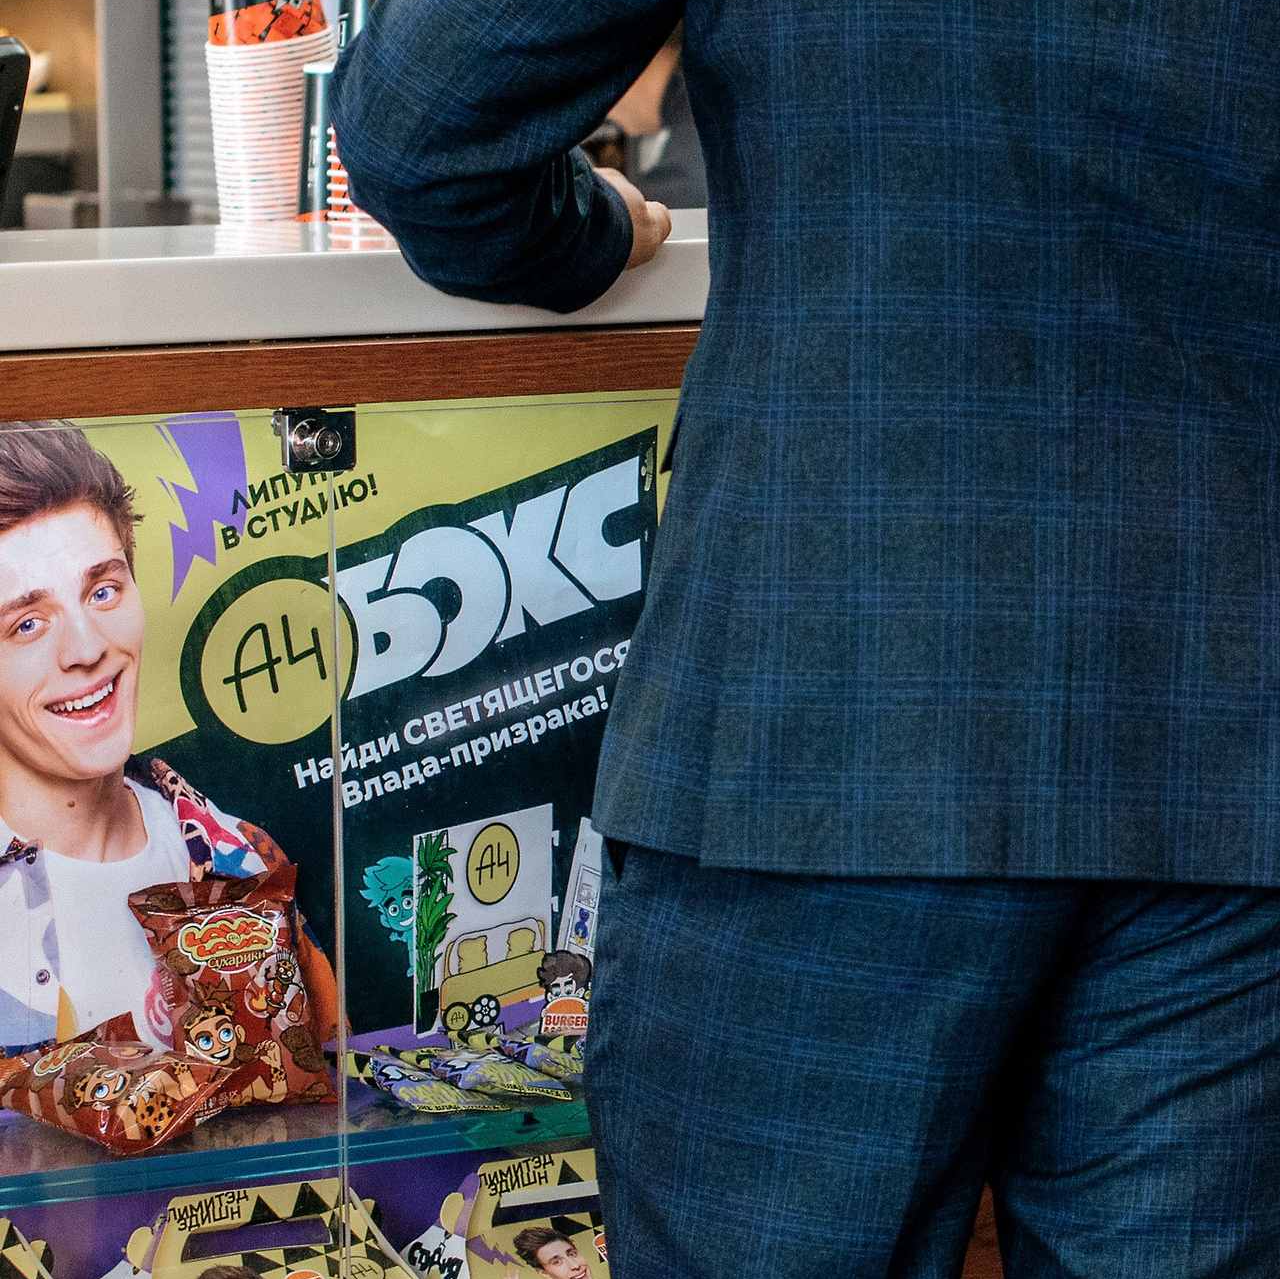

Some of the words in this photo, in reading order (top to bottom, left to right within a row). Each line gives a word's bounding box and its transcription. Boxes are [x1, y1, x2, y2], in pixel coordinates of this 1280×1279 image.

[221, 525, 240, 550] В
[247, 473, 378, 539] СТУДИЮ!
[232, 472, 344, 515] ЛИПУ
[320, 456, 643, 700] БОКС
[223, 615, 328, 713] А4
[294, 732, 400, 788] Найди
[403, 639, 632, 745] СВЕТЯЩЕГОСЯ
[341, 685, 609, 809] Влада-призрака!
[207, 951, 266, 969] Сухарики
[545, 1015, 588, 1027] BURGER
[490, 1171, 549, 1196] ЭДИШН
[178, 1206, 241, 1232] ЭДИШН
